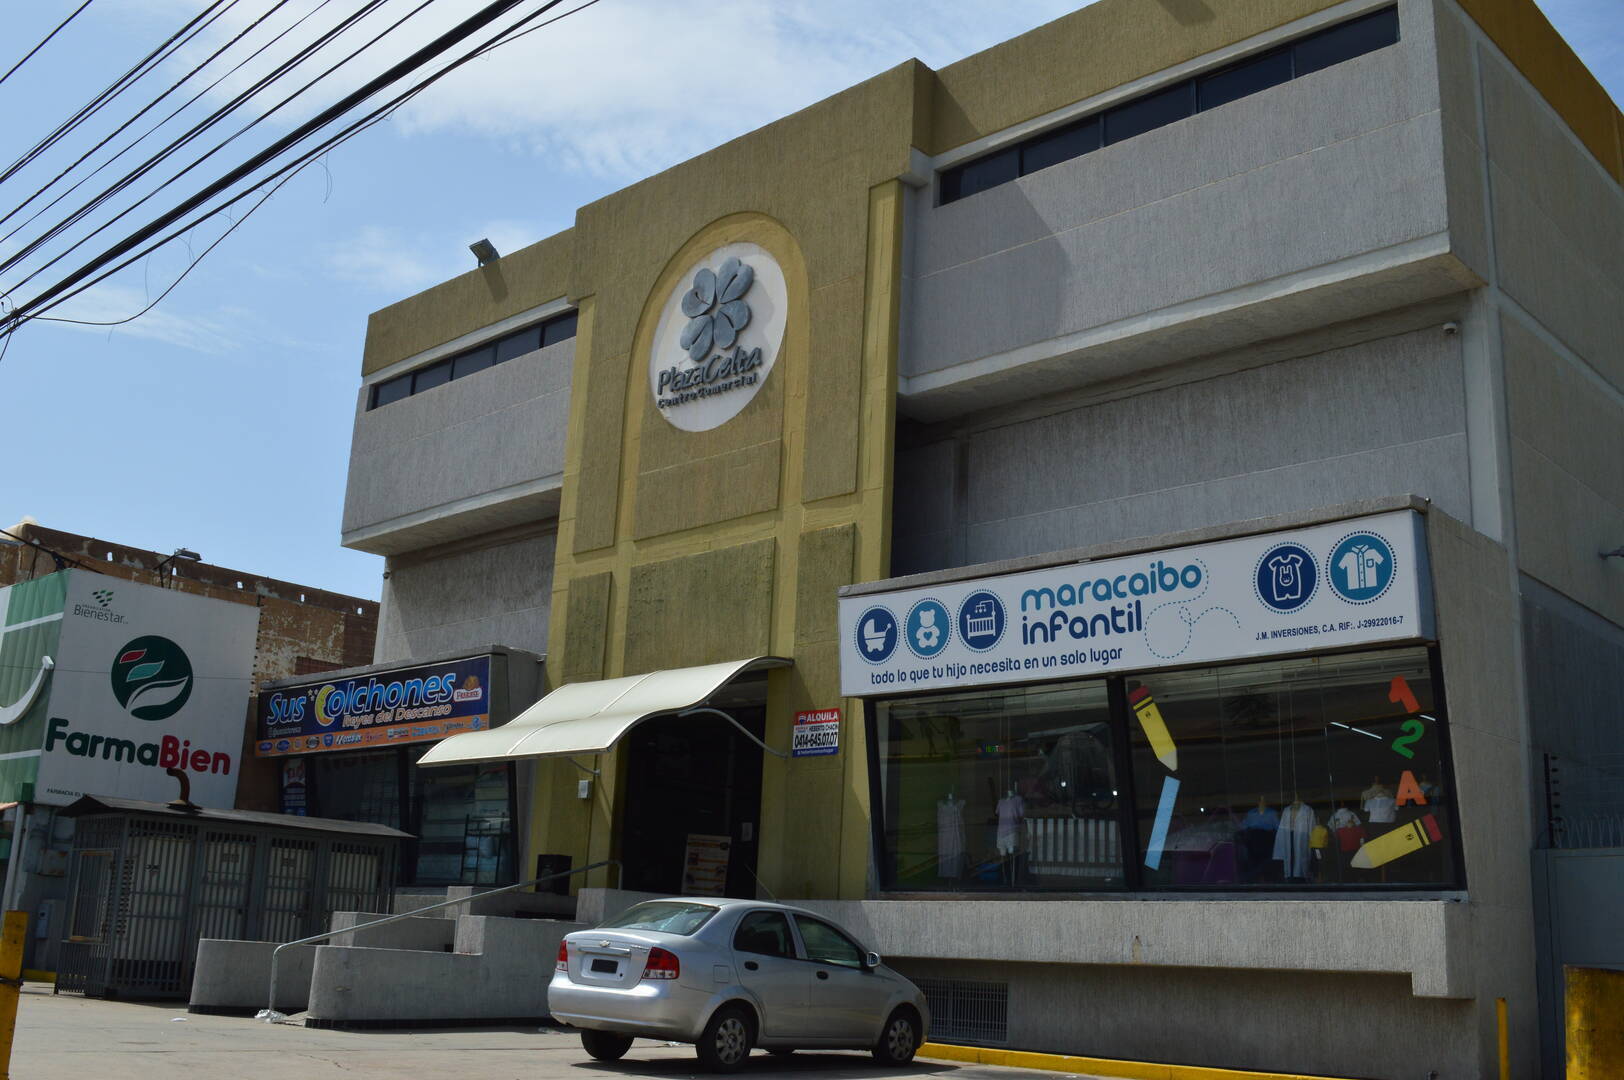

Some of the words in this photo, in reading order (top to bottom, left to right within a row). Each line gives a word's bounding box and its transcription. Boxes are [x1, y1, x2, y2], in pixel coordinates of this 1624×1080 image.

[1020, 560, 1202, 613] maracaibo
[73, 604, 125, 624] Bienestar
[1022, 600, 1142, 645] infantil
[1255, 631, 1269, 641] J.M.
[1271, 625, 1321, 639] INVERSIONES,
[1322, 623, 1337, 633] C.A.
[1357, 616, 1404, 629] J-29922016-7
[871, 669, 895, 685] todo
[897, 668, 906, 682] lo
[909, 669, 930, 683] que
[932, 666, 944, 678] tu
[947, 663, 967, 680] hijo
[970, 657, 1021, 675] necesita
[1024, 658, 1039, 669] en
[1042, 656, 1057, 667] un
[1060, 650, 1086, 665] solo
[1090, 648, 1123, 665] lugar
[266, 692, 307, 726] Sus
[375, 709, 395, 724] del
[395, 703, 452, 721] Descanso
[807, 712, 838, 722] ALQUILA
[45, 717, 231, 776] FarmaBien
[1391, 719, 1424, 759] 2
[1396, 770, 1427, 806] A
